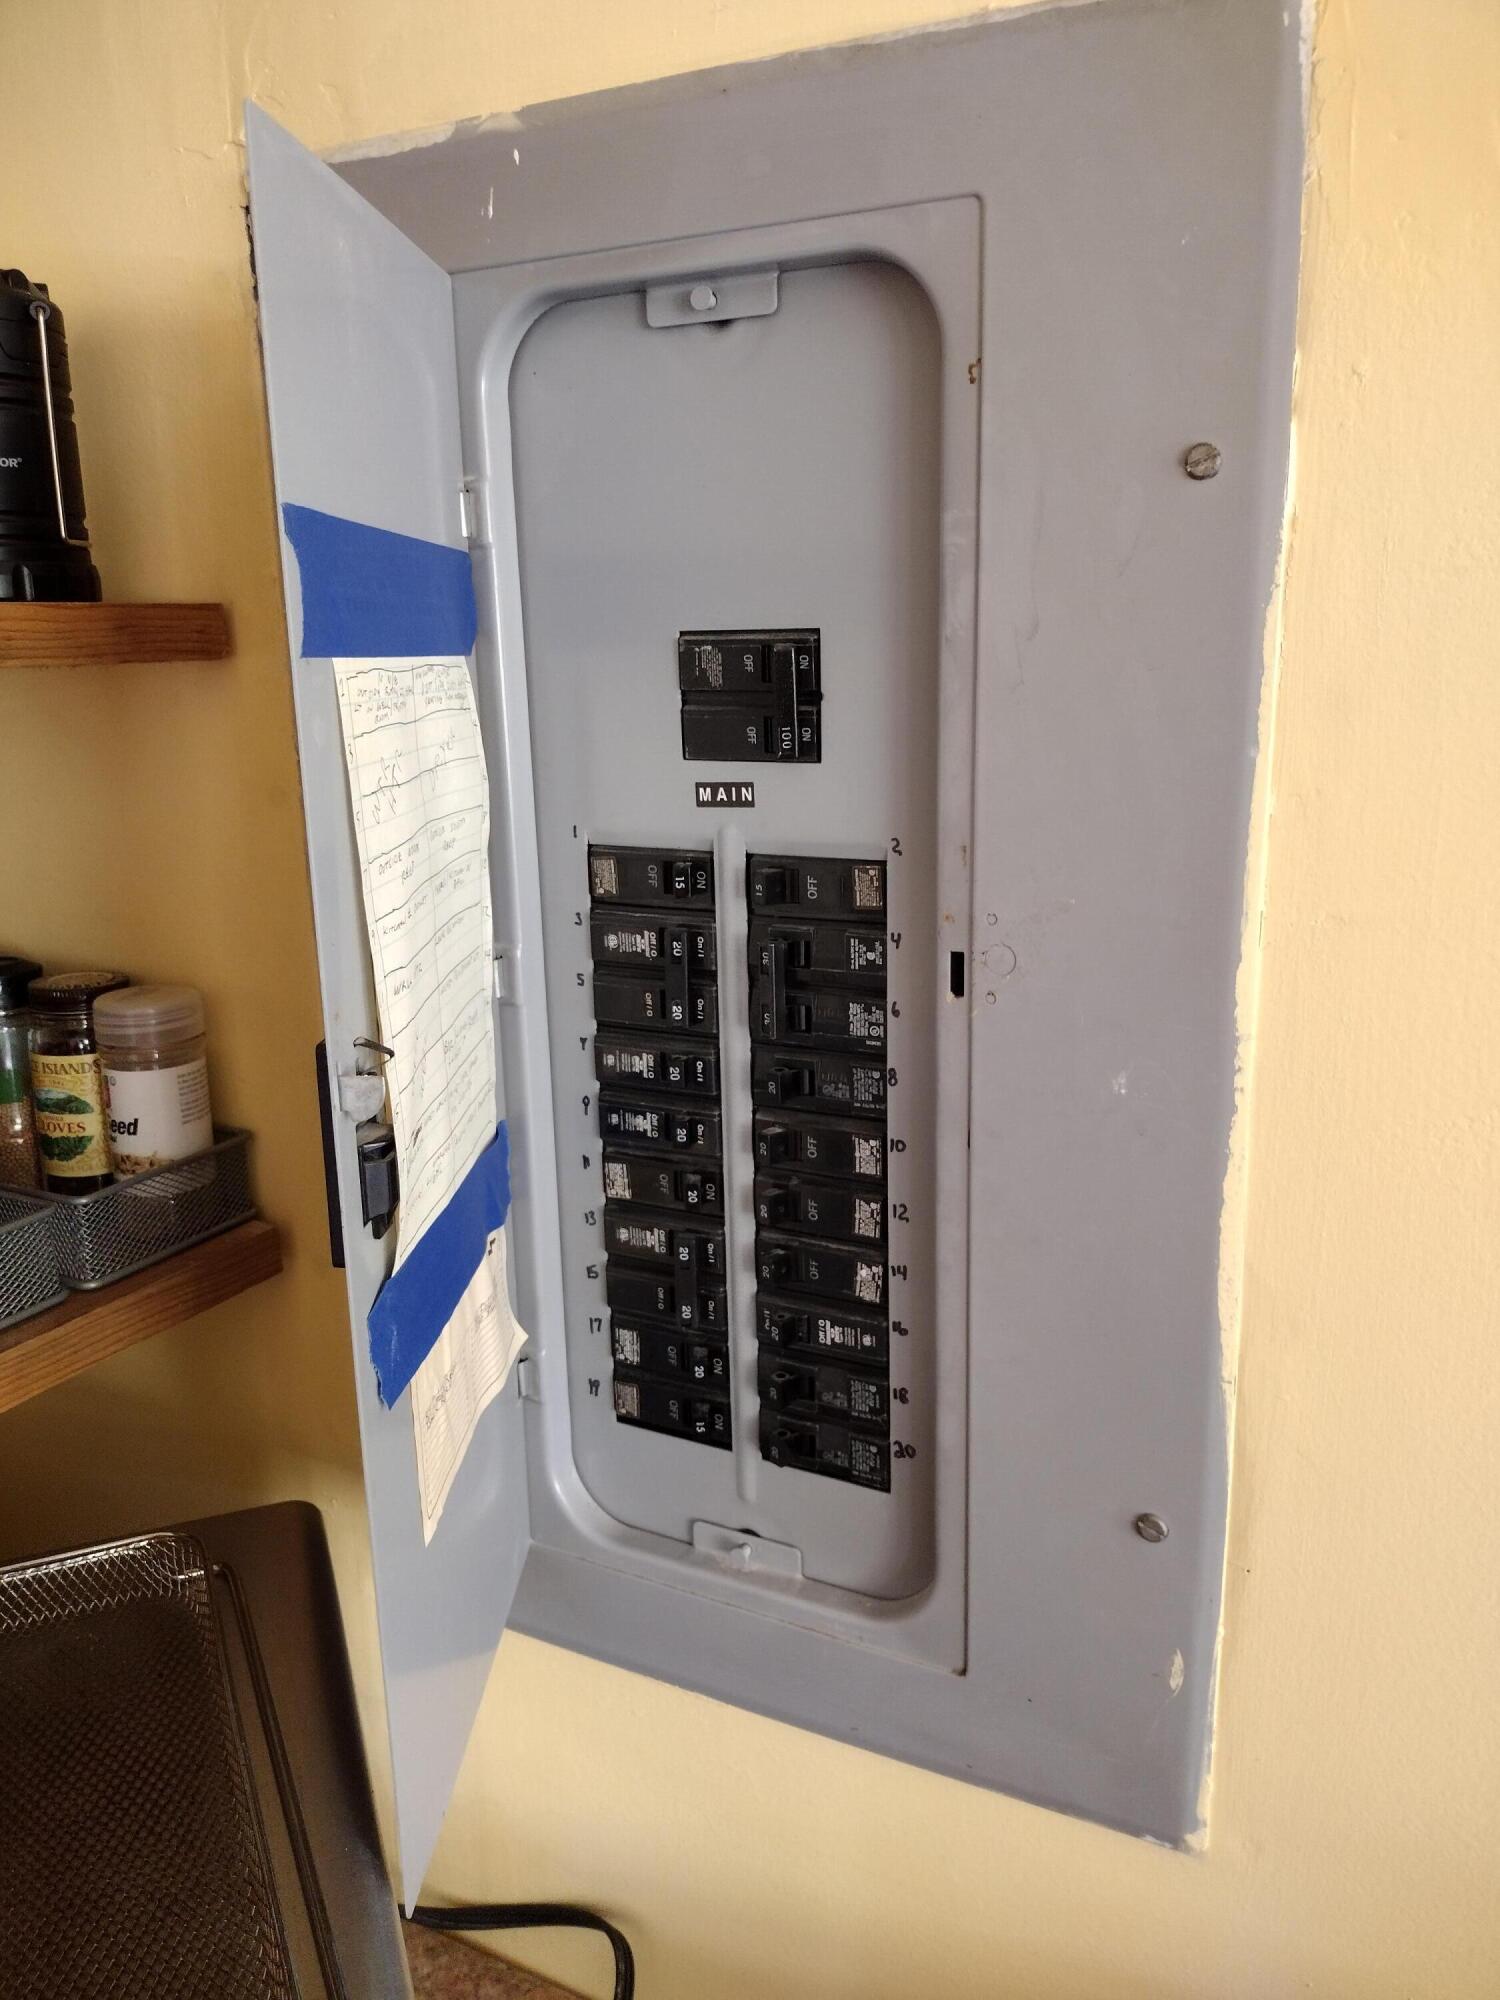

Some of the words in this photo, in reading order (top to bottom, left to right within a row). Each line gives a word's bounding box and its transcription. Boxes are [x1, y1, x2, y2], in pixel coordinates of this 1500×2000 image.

[744, 654, 754, 672] OFF
[800, 655, 808, 670] ON
[747, 726, 756, 744] OFF
[782, 726, 792, 749] 100
[802, 727, 812, 742] ON
[698, 786, 752, 802] MAIN
[572, 824, 578, 838] 1
[890, 838, 902, 856] 2
[648, 864, 658, 888] OFF
[675, 876, 686, 890] 15
[696, 872, 706, 889] ON
[756, 884, 763, 896] 15
[808, 875, 818, 900] OFF
[574, 912, 582, 926] 3
[890, 932, 902, 949] 4
[673, 941, 682, 957] 20
[576, 973, 584, 986] 5
[672, 1005, 682, 1020] 20
[891, 1001, 900, 1018] 6
[41, 1058, 102, 1075] ISLANDS
[670, 1066, 680, 1081] 20
[888, 1068, 898, 1087] 8
[768, 1082, 776, 1095] 20
[582, 1096, 590, 1116] 9
[677, 1128, 686, 1143] 20
[808, 1136, 818, 1158] OFF
[890, 1139, 907, 1153] 10
[660, 1174, 670, 1195] OFF
[706, 1184, 716, 1200] ON
[688, 1190, 698, 1204] 20
[584, 1210, 596, 1226] 13
[760, 1204, 768, 1218] 20
[808, 1199, 818, 1221] OFF
[892, 1203, 910, 1224] 12
[679, 1246, 690, 1261] 20
[586, 1264, 599, 1279] 15
[762, 1266, 770, 1280] 20
[810, 1257, 818, 1280] OFF
[890, 1264, 908, 1281] 14
[681, 1305, 692, 1319] 20
[589, 1317, 602, 1334] 17
[771, 1326, 779, 1341] 20
[668, 1346, 677, 1367] OFF
[694, 1365, 704, 1379] 20
[712, 1358, 722, 1375] ON
[588, 1378, 600, 1397] 19
[893, 1387, 910, 1404] 18
[669, 1400, 679, 1422] OFF
[696, 1422, 706, 1433] 15
[714, 1414, 724, 1430] ON
[893, 1440, 916, 1459] 20
